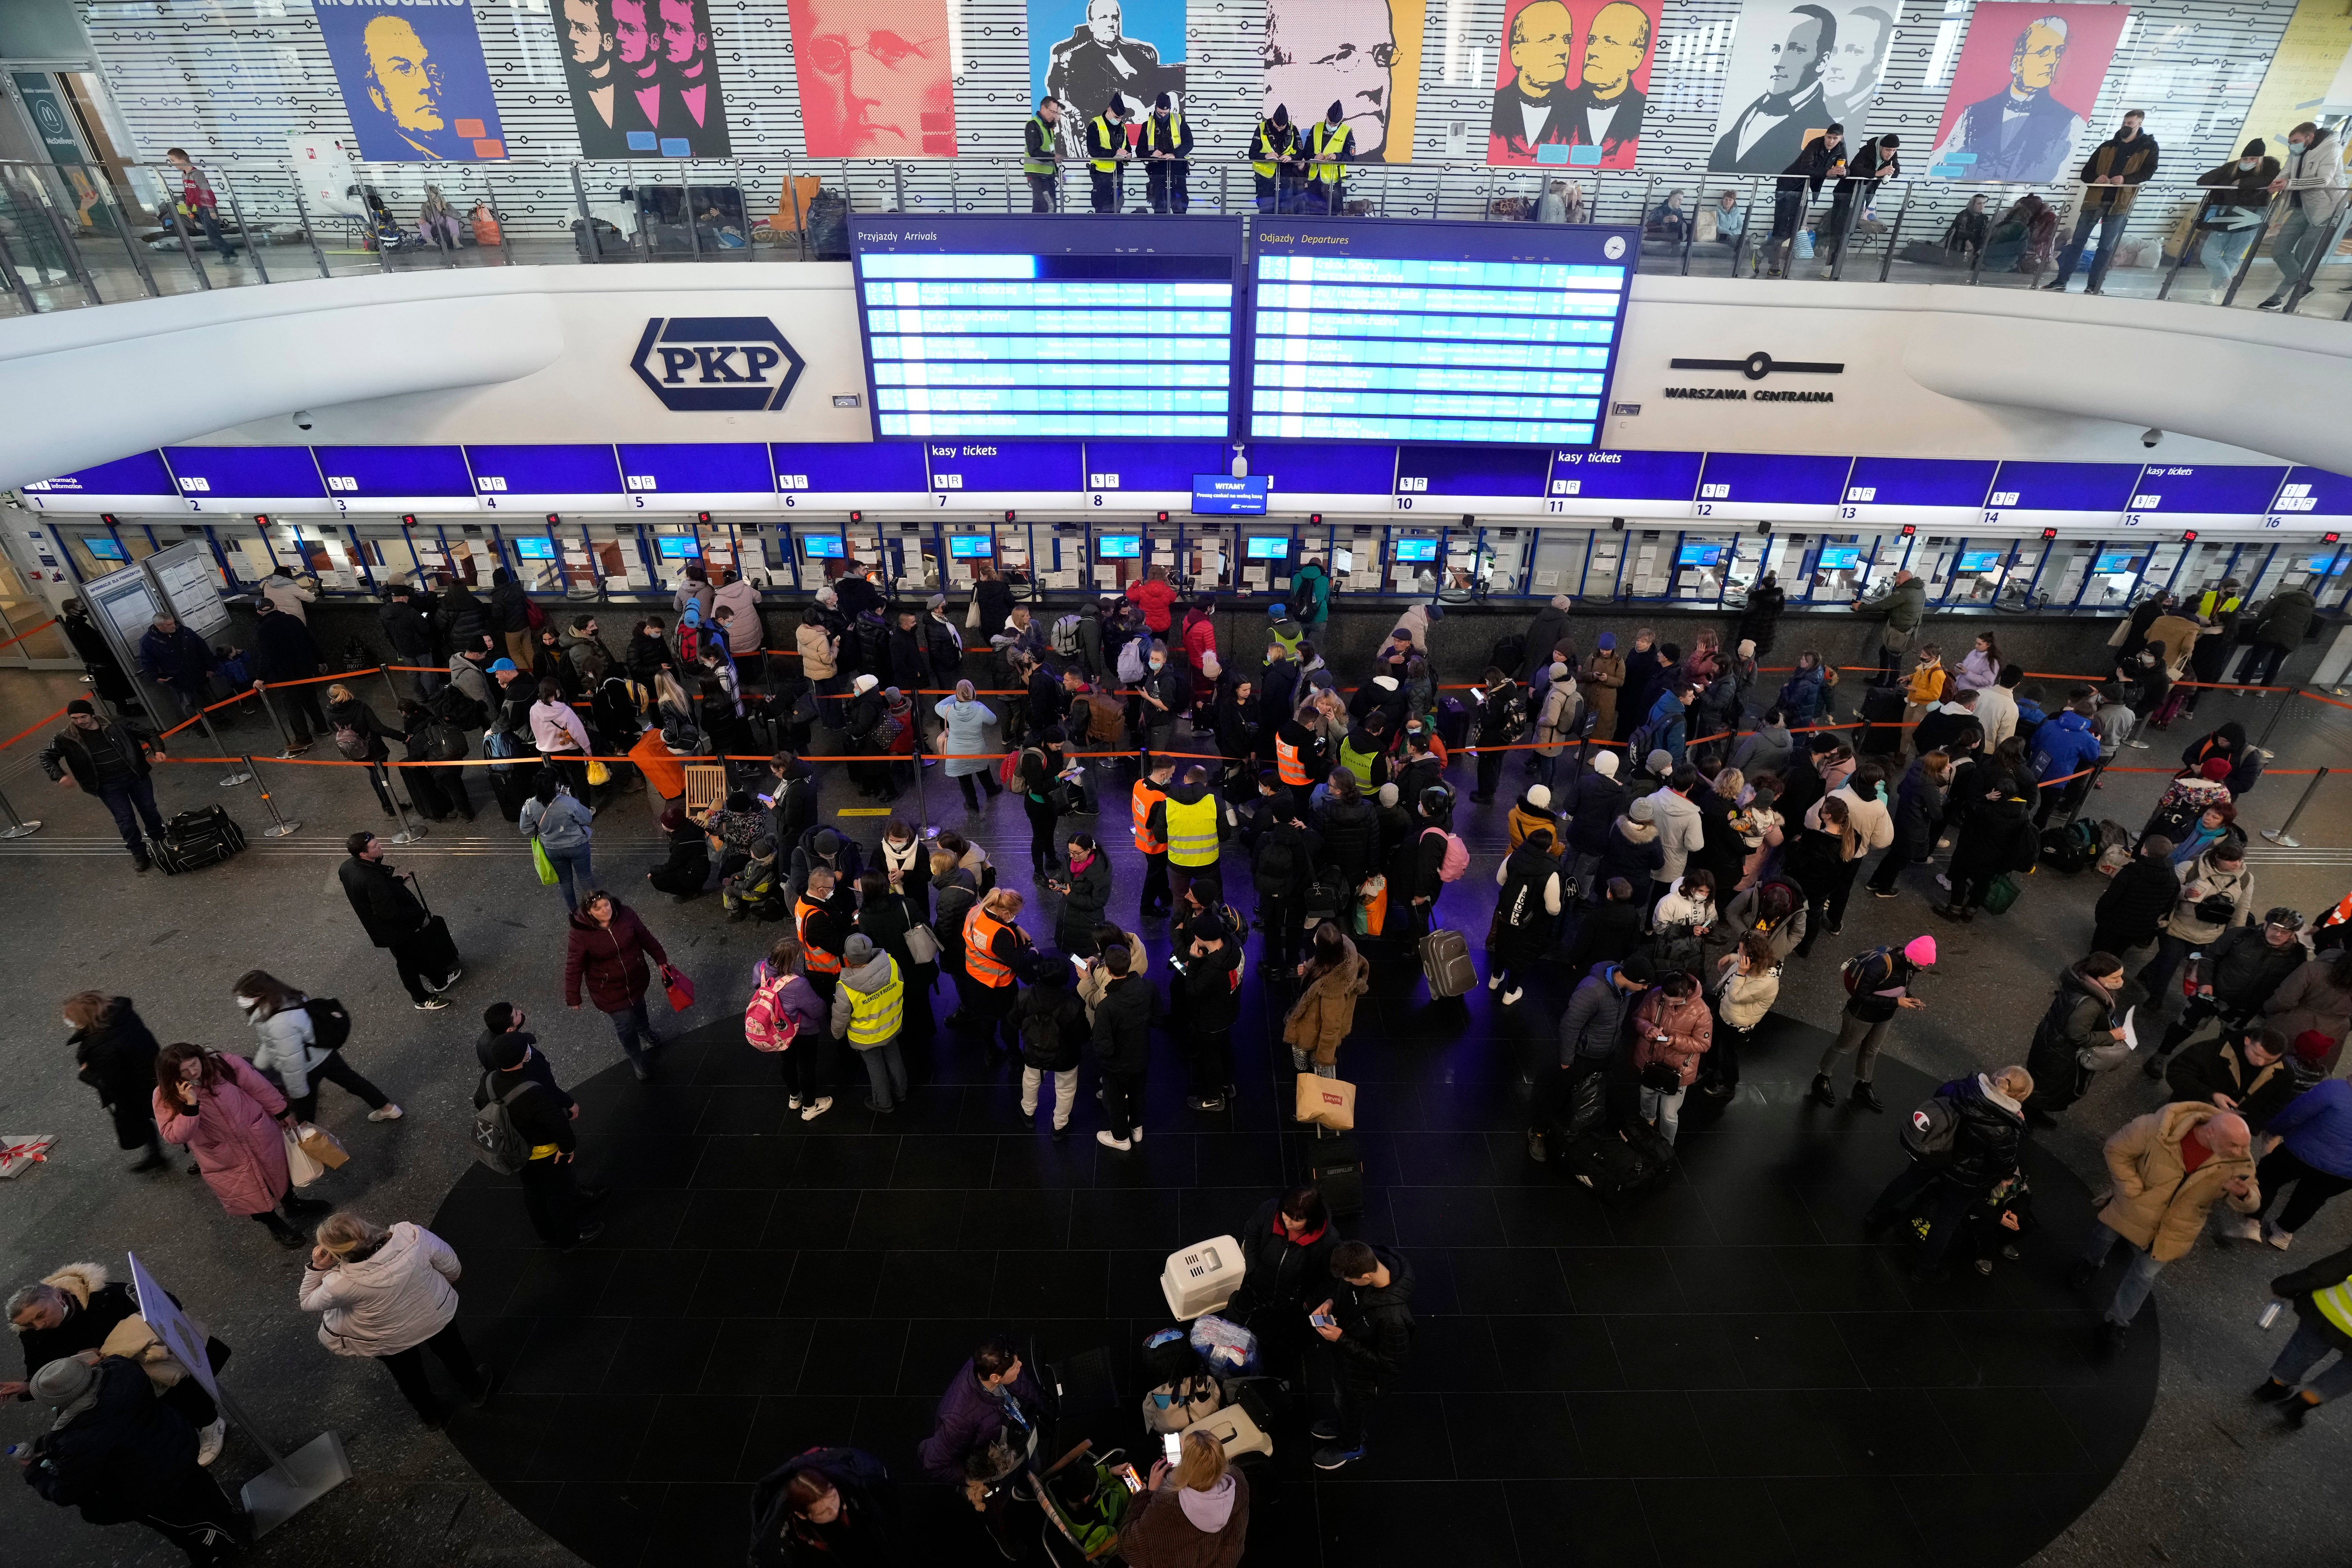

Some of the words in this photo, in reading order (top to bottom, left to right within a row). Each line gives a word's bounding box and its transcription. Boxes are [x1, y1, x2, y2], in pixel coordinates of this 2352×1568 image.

[46, 137, 76, 146] McDelivery
[858, 232, 897, 242] Przyjazdy
[905, 232, 937, 240] Arrivals
[1260, 233, 1295, 244] Odjazdy
[1301, 235, 1349, 245] Departures
[657, 346, 779, 383] PKP
[1665, 388, 1746, 400] WARSZAWA
[1753, 390, 1834, 402] CENTRALNA
[932, 446, 956, 458] kasy
[963, 446, 997, 456] tickets
[1558, 451, 1583, 464] kasy
[1588, 452, 1621, 463] tickets
[2147, 467, 2166, 477] kasy
[346, 479, 353, 487] R
[495, 479, 503, 487] R
[645, 478, 652, 486] R
[798, 477, 804, 485] R
[34, 497, 44, 508] 1
[190, 500, 201, 511] 2
[337, 500, 347, 511] 3
[487, 498, 496, 508] 4
[636, 497, 644, 507] 5
[786, 496, 795, 507] 6
[939, 496, 947, 506] 7
[1094, 495, 1102, 506] 8
[1397, 498, 1412, 509] 10
[1550, 501, 1563, 512] 11
[1697, 504, 1712, 516] 12
[1842, 508, 1856, 518] 13
[1984, 512, 1998, 523] 14
[2125, 515, 2140, 526] 15
[2265, 517, 2281, 528] 16
[90, 582, 112, 593] INFORMACJE
[120, 569, 141, 581] PODRÓŻNYCH
[1512, 890, 1527, 924] adidas
[862, 993, 881, 1005] WOJEWÓDZKI
[883, 982, 897, 993] WARSZAWIE
